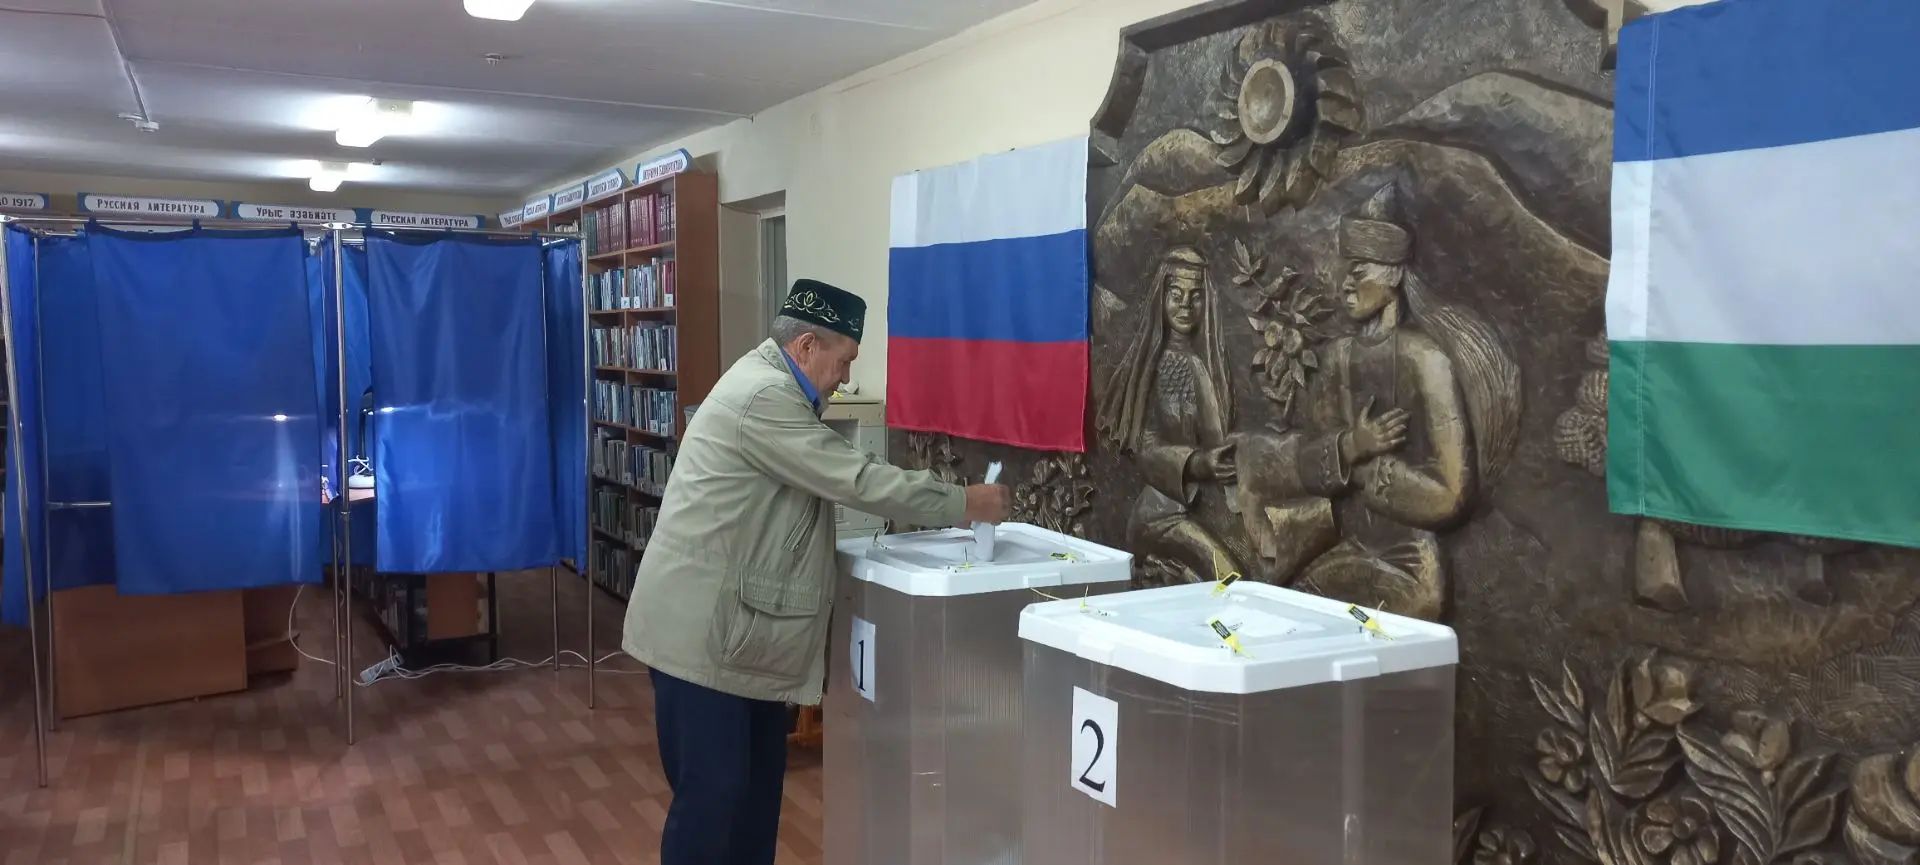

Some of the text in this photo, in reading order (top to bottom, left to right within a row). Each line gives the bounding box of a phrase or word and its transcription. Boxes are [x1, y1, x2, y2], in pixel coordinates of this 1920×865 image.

[97, 199, 205, 214] РУССКАЯ ЛИТЕРАТУРА
[380, 213, 469, 227] РУССКАЯ ЛИТЕРАТУРА
[858, 639, 866, 692] 1
[1078, 718, 1106, 793] 2
